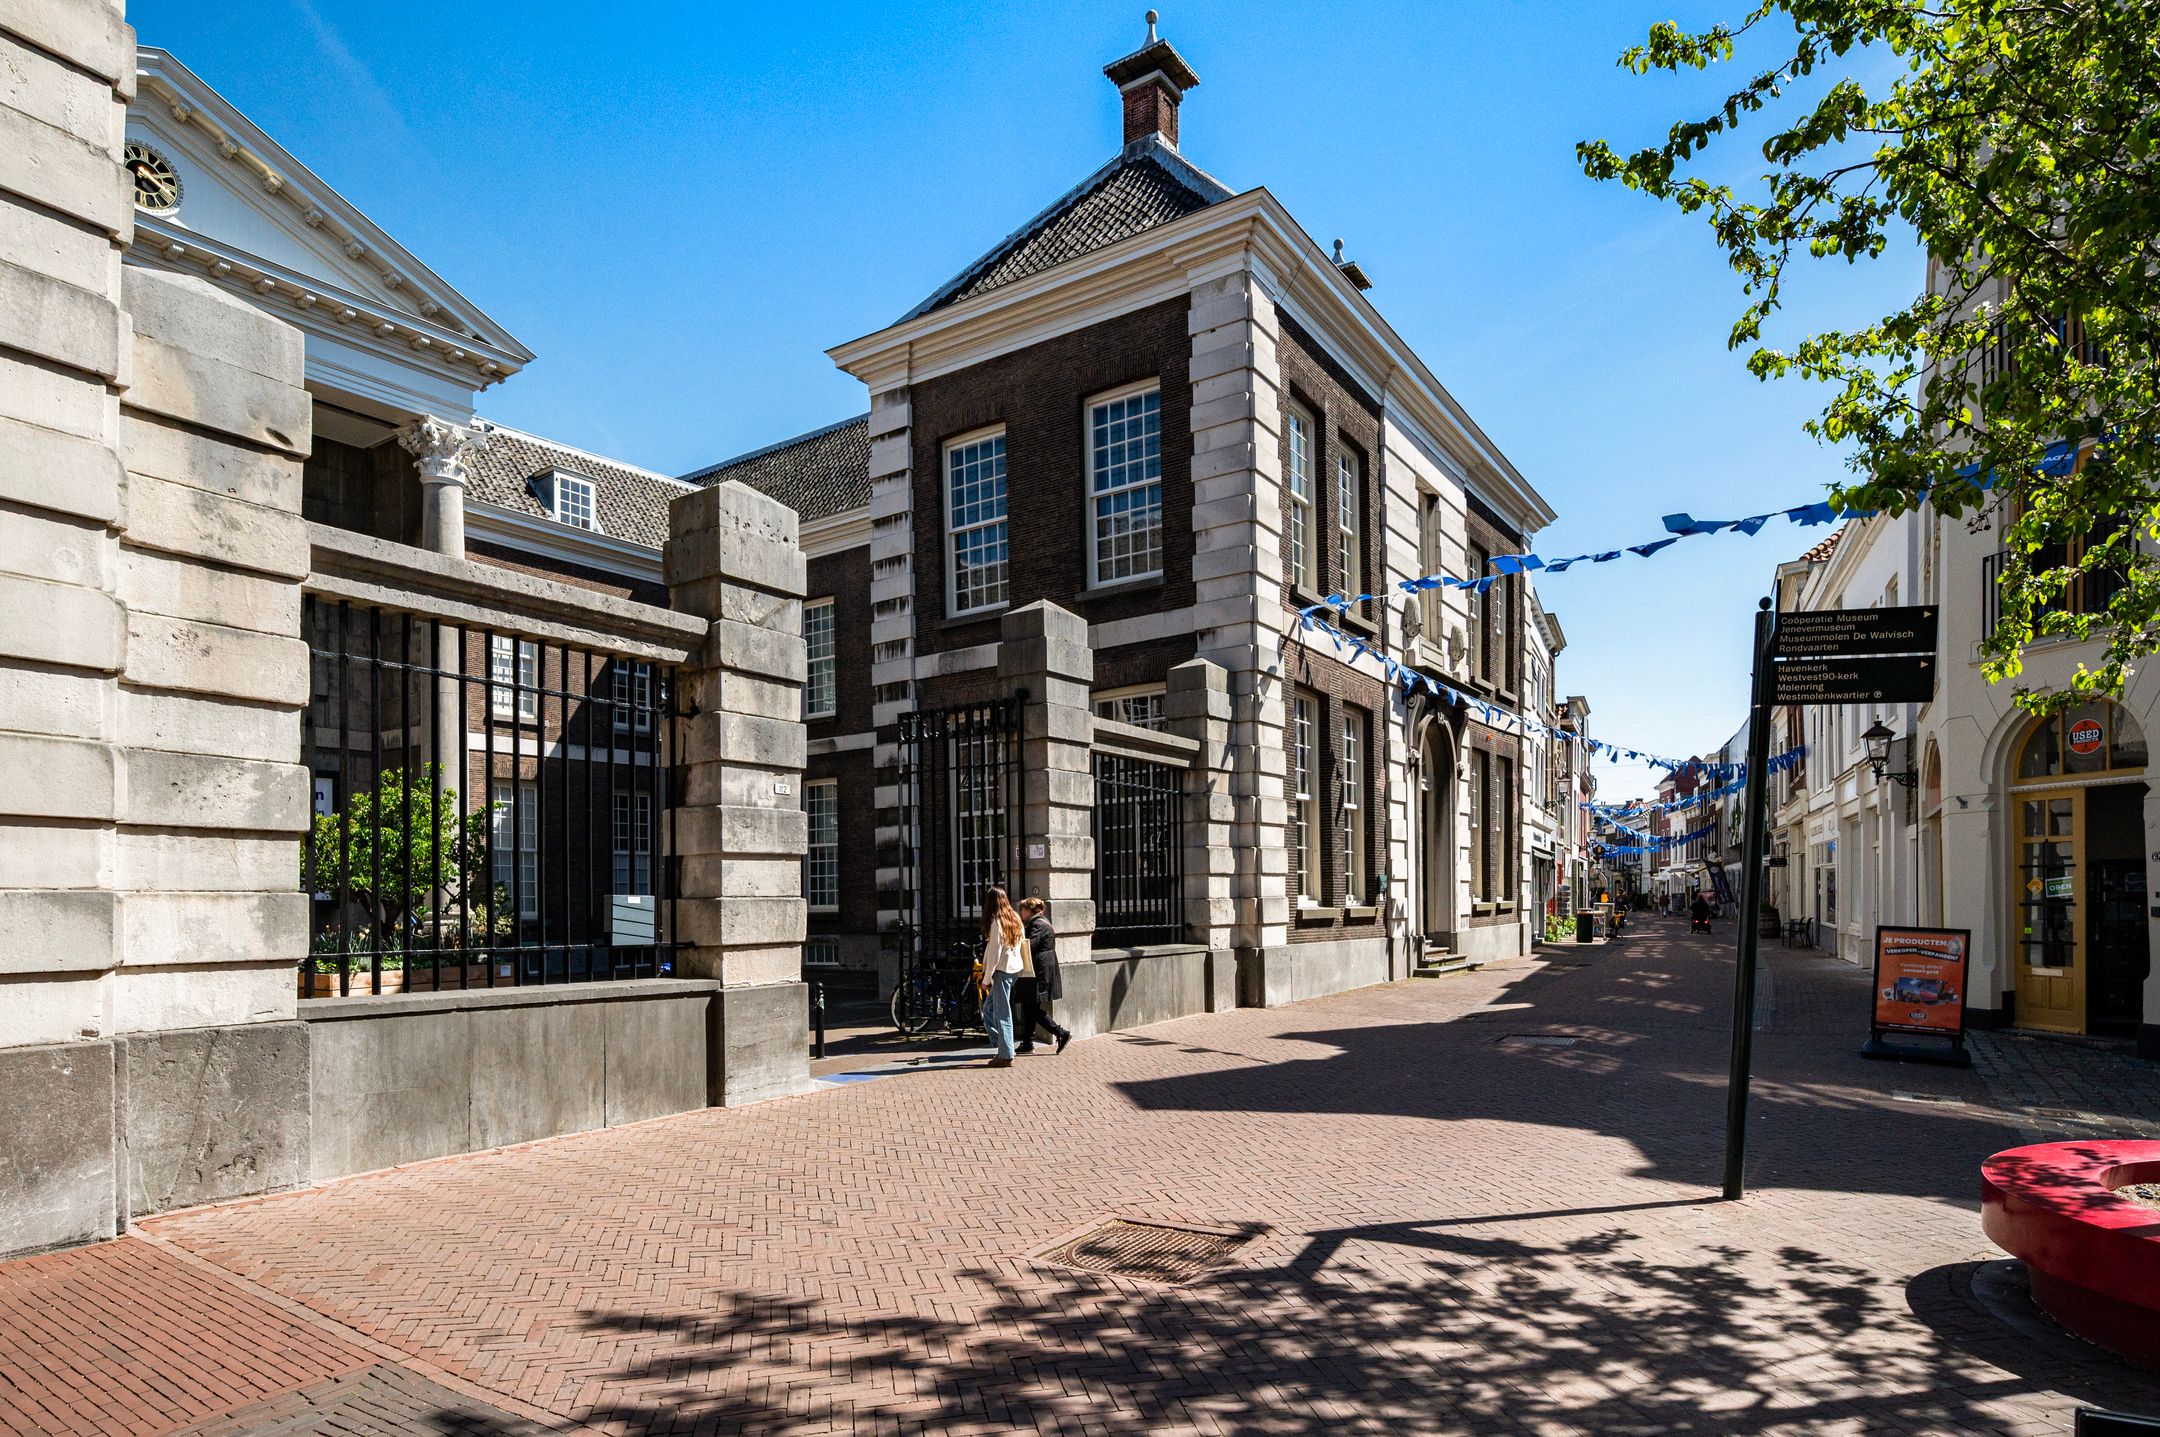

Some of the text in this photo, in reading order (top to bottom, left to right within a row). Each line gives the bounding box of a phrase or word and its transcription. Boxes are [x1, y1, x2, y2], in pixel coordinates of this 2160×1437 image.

[1781, 613, 1879, 625] Coöperatie Museum
[1780, 623, 1855, 634] Jenevermuseum
[1779, 629, 1914, 643] Museummolen De Walvisch
[1779, 643, 1839, 653] Rondvaarten
[1778, 663, 1828, 673] Havenkerk
[1778, 672, 1859, 682] Westvest90-kerk
[1777, 682, 1824, 692] Molenring
[1777, 690, 1870, 701] Westmolenkwartier
[2072, 729, 2100, 740] USED
[2049, 883, 2072, 892] OPEN
[1894, 937, 1947, 946] PRODUCTEN
[1920, 949, 1959, 961] VERPANDEN?
